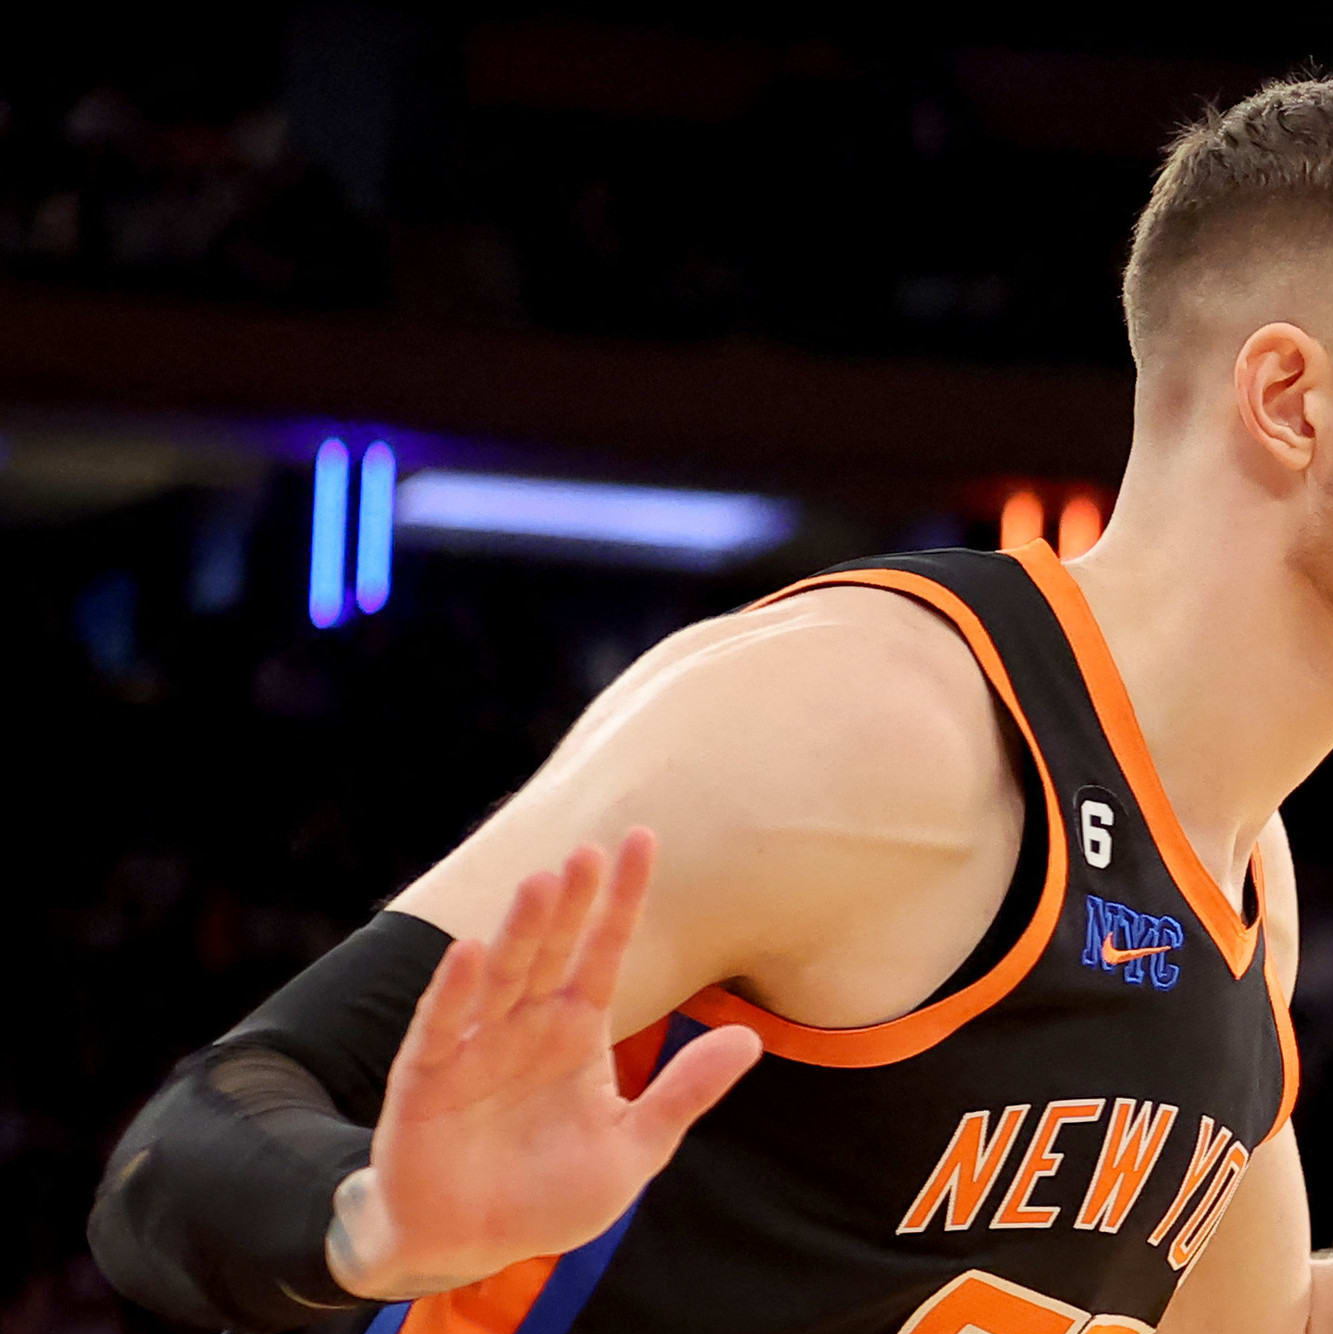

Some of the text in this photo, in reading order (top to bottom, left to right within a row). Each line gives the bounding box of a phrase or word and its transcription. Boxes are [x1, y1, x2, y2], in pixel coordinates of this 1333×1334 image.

[1081, 799, 1115, 870] 6
[1081, 894, 1185, 991] NYC
[895, 1097, 1251, 1287] NEW YO
